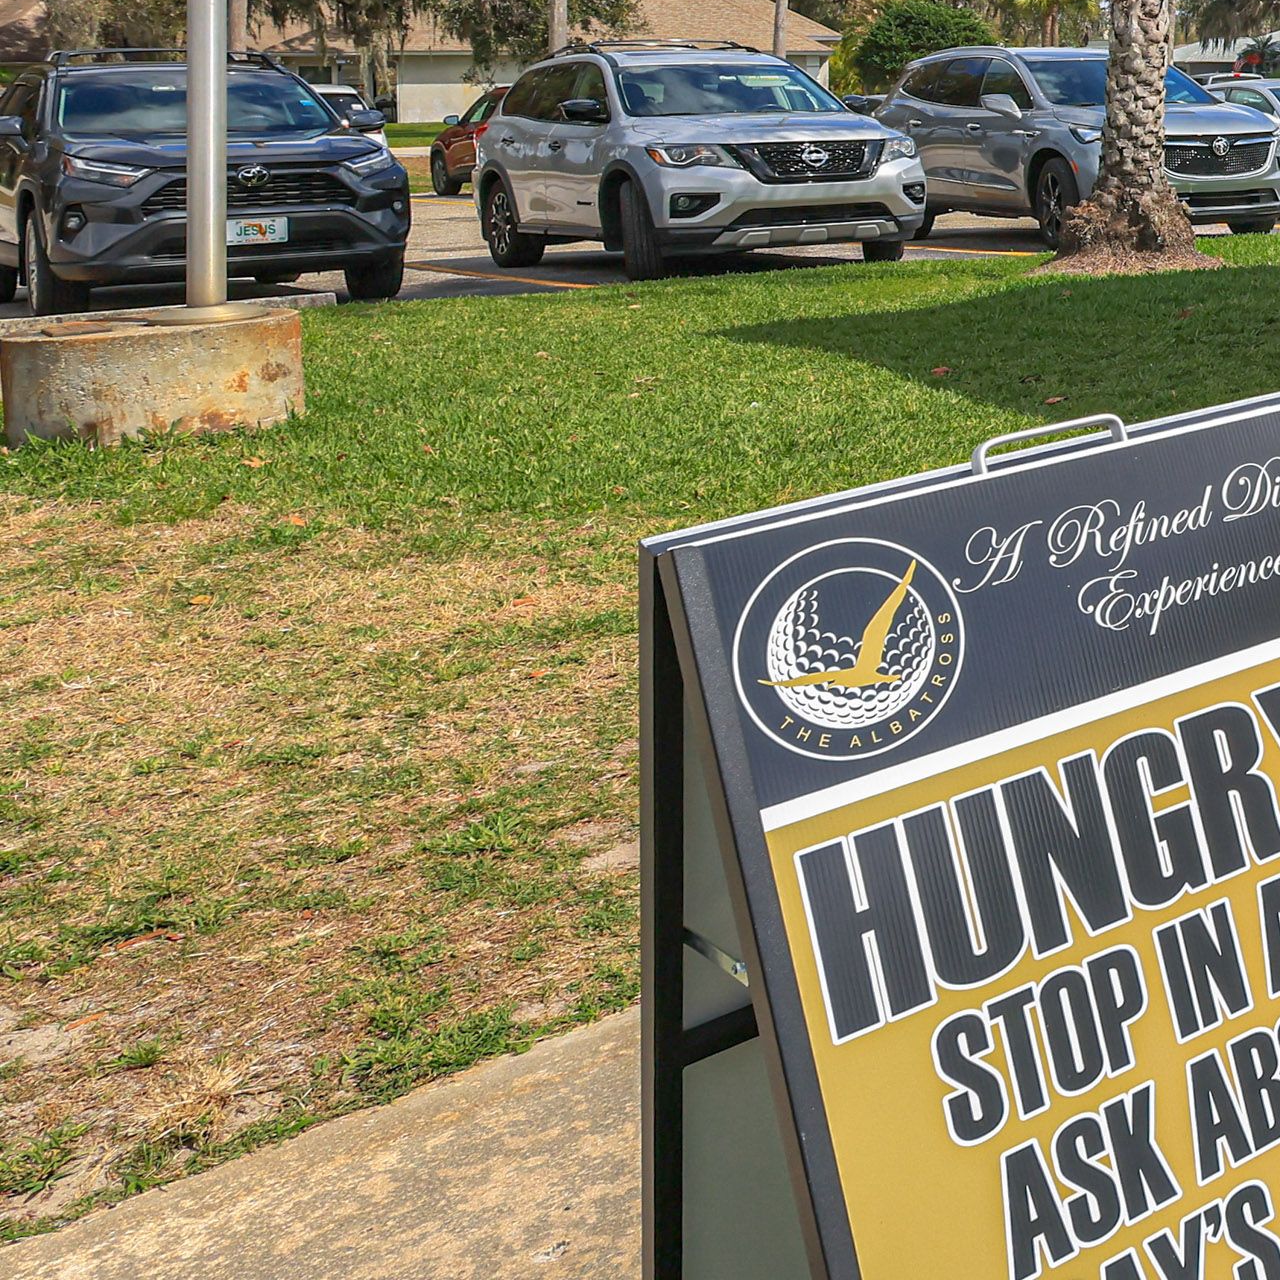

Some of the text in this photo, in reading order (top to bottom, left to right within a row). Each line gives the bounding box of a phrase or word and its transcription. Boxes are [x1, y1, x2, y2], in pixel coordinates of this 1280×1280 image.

[955, 519, 1043, 594] A
[1046, 484, 1213, 572] Refined
[779, 612, 954, 748] THE ALBATROSS
[932, 944, 1147, 1146] STOP
[1152, 897, 1252, 1044] IN
[1000, 1080, 1182, 1280] ASK
